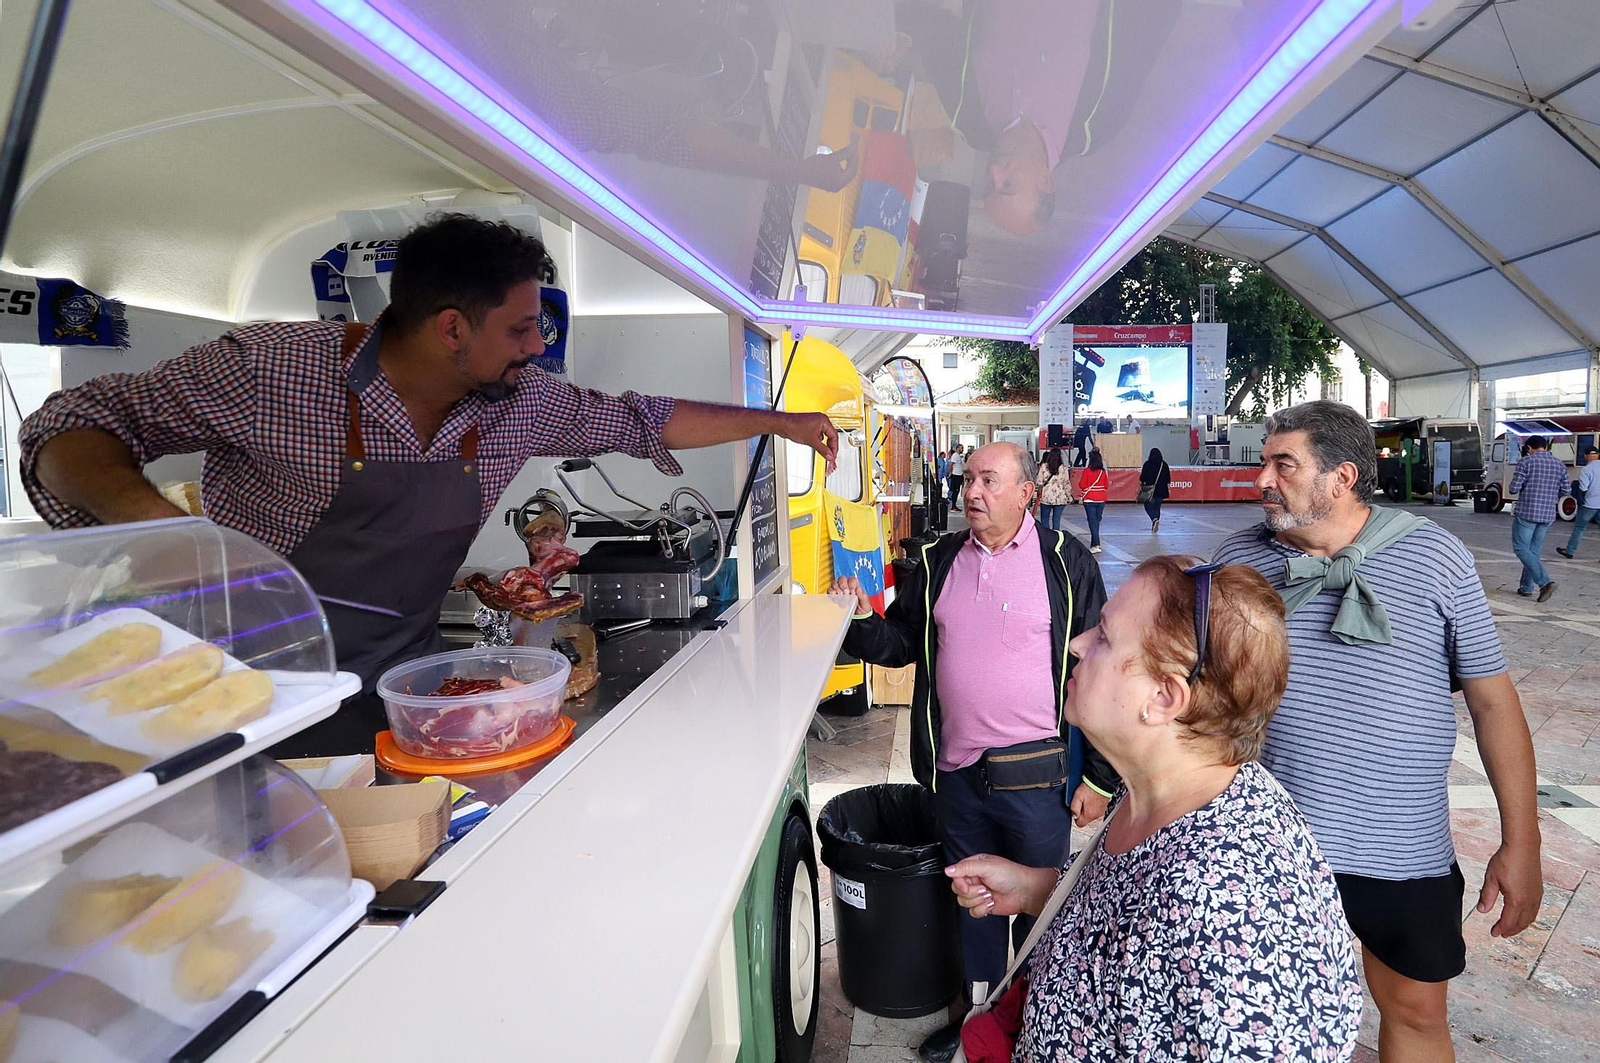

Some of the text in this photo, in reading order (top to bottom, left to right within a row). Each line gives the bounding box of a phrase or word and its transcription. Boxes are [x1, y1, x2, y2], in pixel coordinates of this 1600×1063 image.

[363, 252, 397, 262] AVENID
[1169, 481, 1192, 490] ampo
[843, 883, 864, 899] 100L
